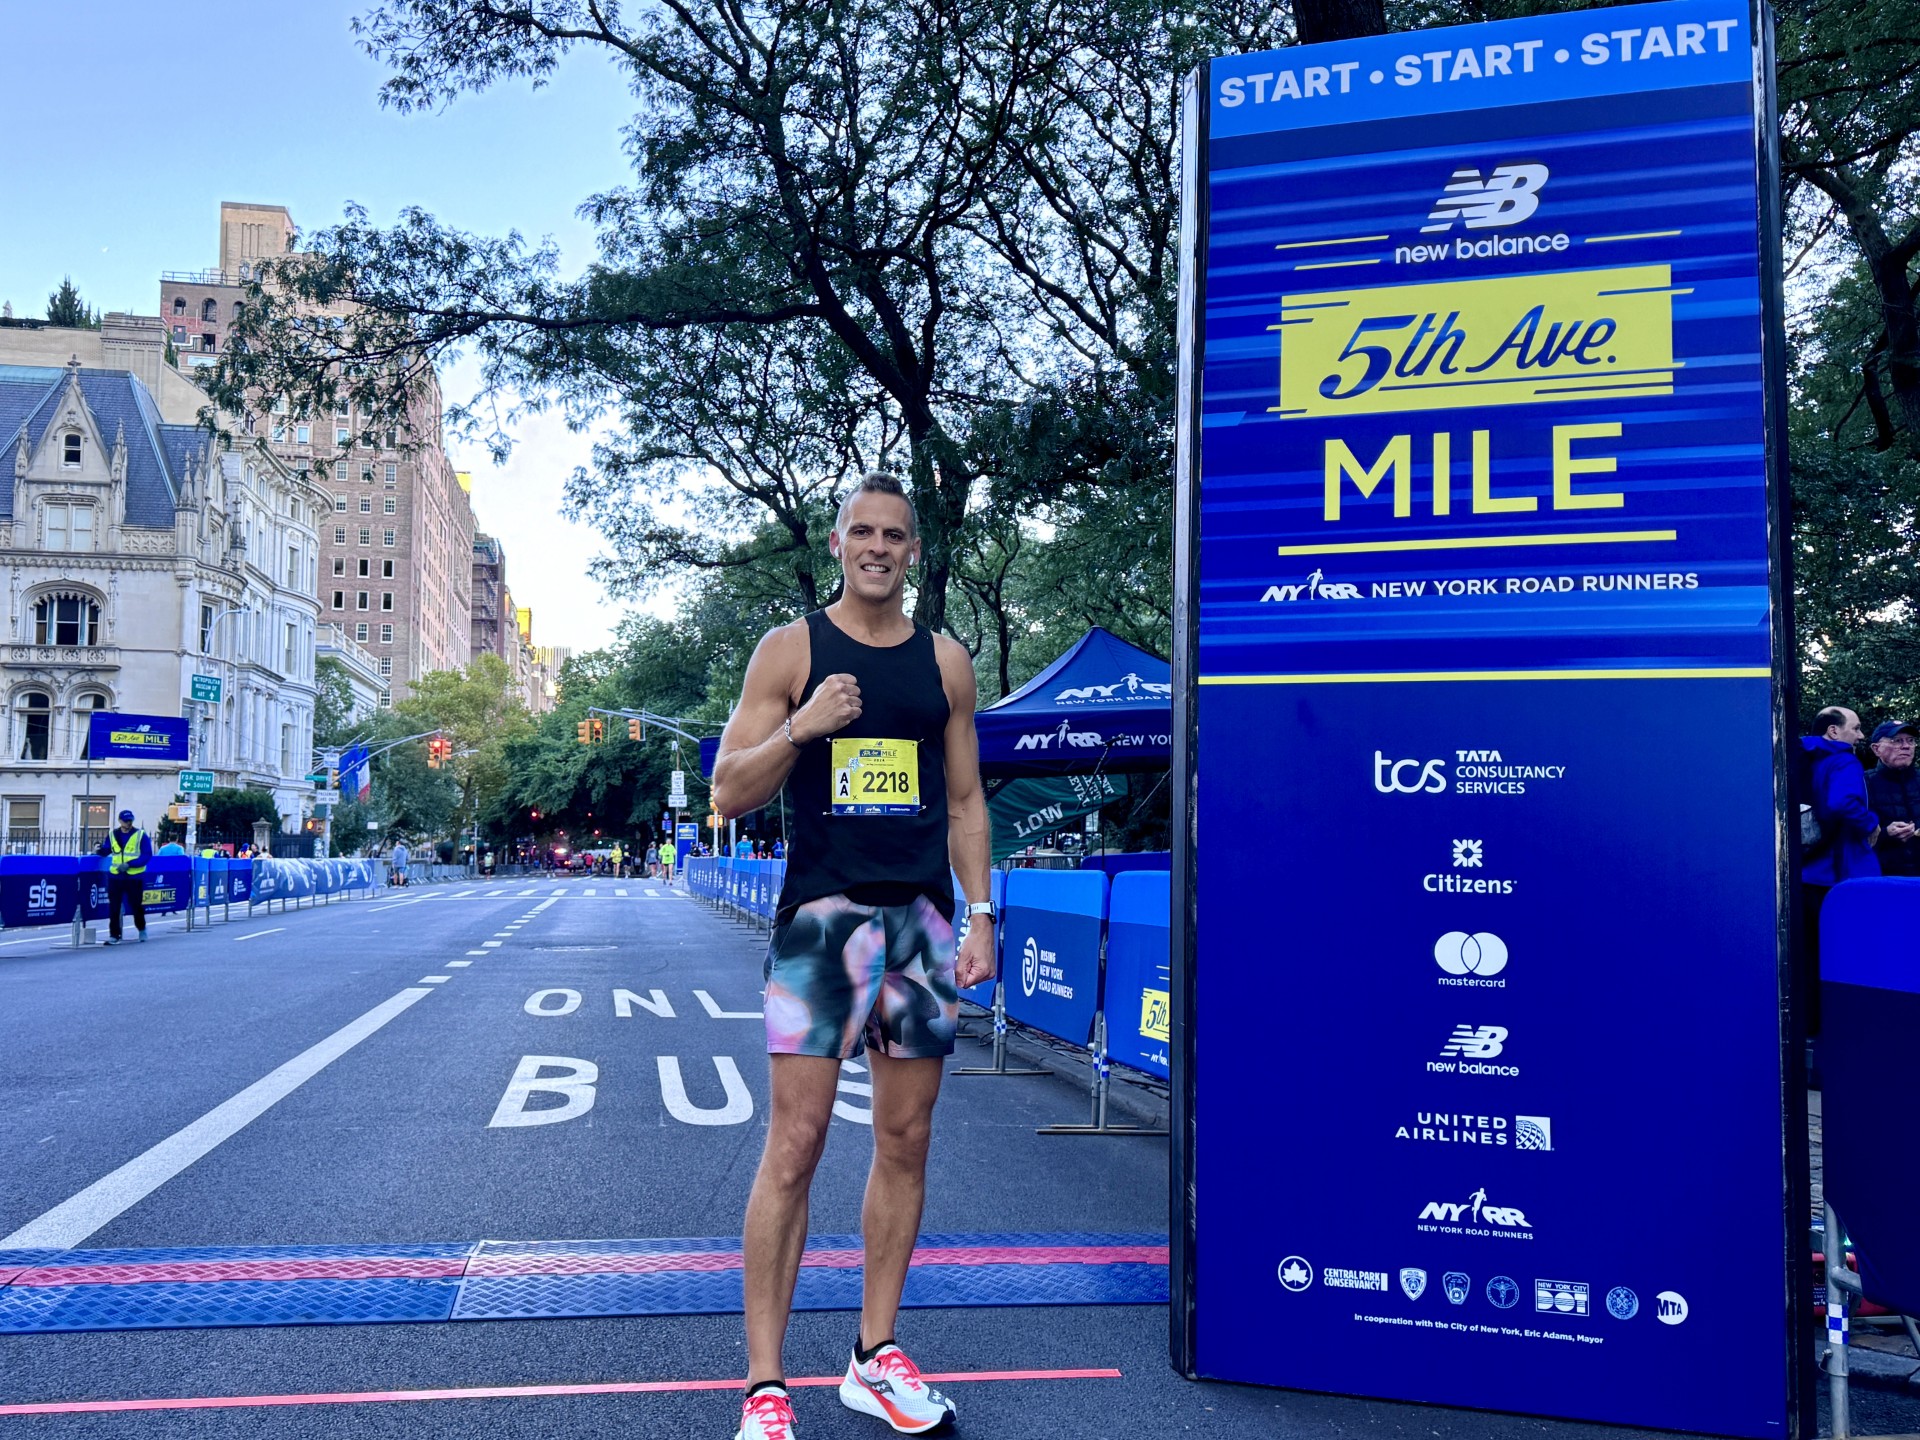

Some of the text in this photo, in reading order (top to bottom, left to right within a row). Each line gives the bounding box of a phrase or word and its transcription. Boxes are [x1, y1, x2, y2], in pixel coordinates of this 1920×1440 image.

[1220, 19, 1738, 108] START START START
[1395, 233, 1570, 264] new balance
[1318, 304, 1617, 400] 5th Ave.
[1324, 422, 1624, 521] MILE
[1372, 581, 1426, 598] NEW
[1434, 579, 1499, 596] YORK
[1506, 576, 1574, 594] ROAD
[1583, 573, 1698, 592] RUNNERS
[1054, 679, 1171, 700] NYR
[145, 735, 170, 744] MILE
[1148, 735, 1171, 746] YO
[863, 771, 909, 793] 2218
[1374, 750, 1502, 794] tcs TATA
[1456, 765, 1565, 779] CONSULTANCY
[1456, 781, 1526, 794] SERVICES
[1013, 802, 1063, 838] LOW
[1424, 874, 1513, 894] Citizens
[1040, 964, 1063, 981] NEW YORK
[1438, 976, 1506, 988] mastercard
[1038, 979, 1073, 999] ROAD RUNNERS
[524, 989, 764, 1018] ONL
[1146, 1000, 1166, 1029] 5th
[1427, 1062, 1519, 1077] new balance
[1418, 1112, 1507, 1129] UNITED
[1395, 1126, 1508, 1145] AIRLINES
[1418, 1224, 1533, 1240] NEW YORK ROAD RUNNERS
[1324, 1268, 1380, 1281] CENTRAL PARK
[1324, 1277, 1380, 1290] CONSERVANCY
[1555, 1283, 1570, 1291] YORK
[1537, 1290, 1588, 1313] DOT
[1657, 1297, 1683, 1316] MTA
[1354, 1313, 1362, 1321] In
[1364, 1316, 1413, 1326] cooperation
[1415, 1320, 1434, 1328] with
[1435, 1321, 1449, 1329] the
[1451, 1323, 1467, 1332] City
[1481, 1326, 1499, 1334] New
[1501, 1327, 1522, 1336] York,
[1524, 1329, 1541, 1338] Eric
[1543, 1331, 1575, 1341] Adams,
[1577, 1334, 1603, 1344] Mayor
